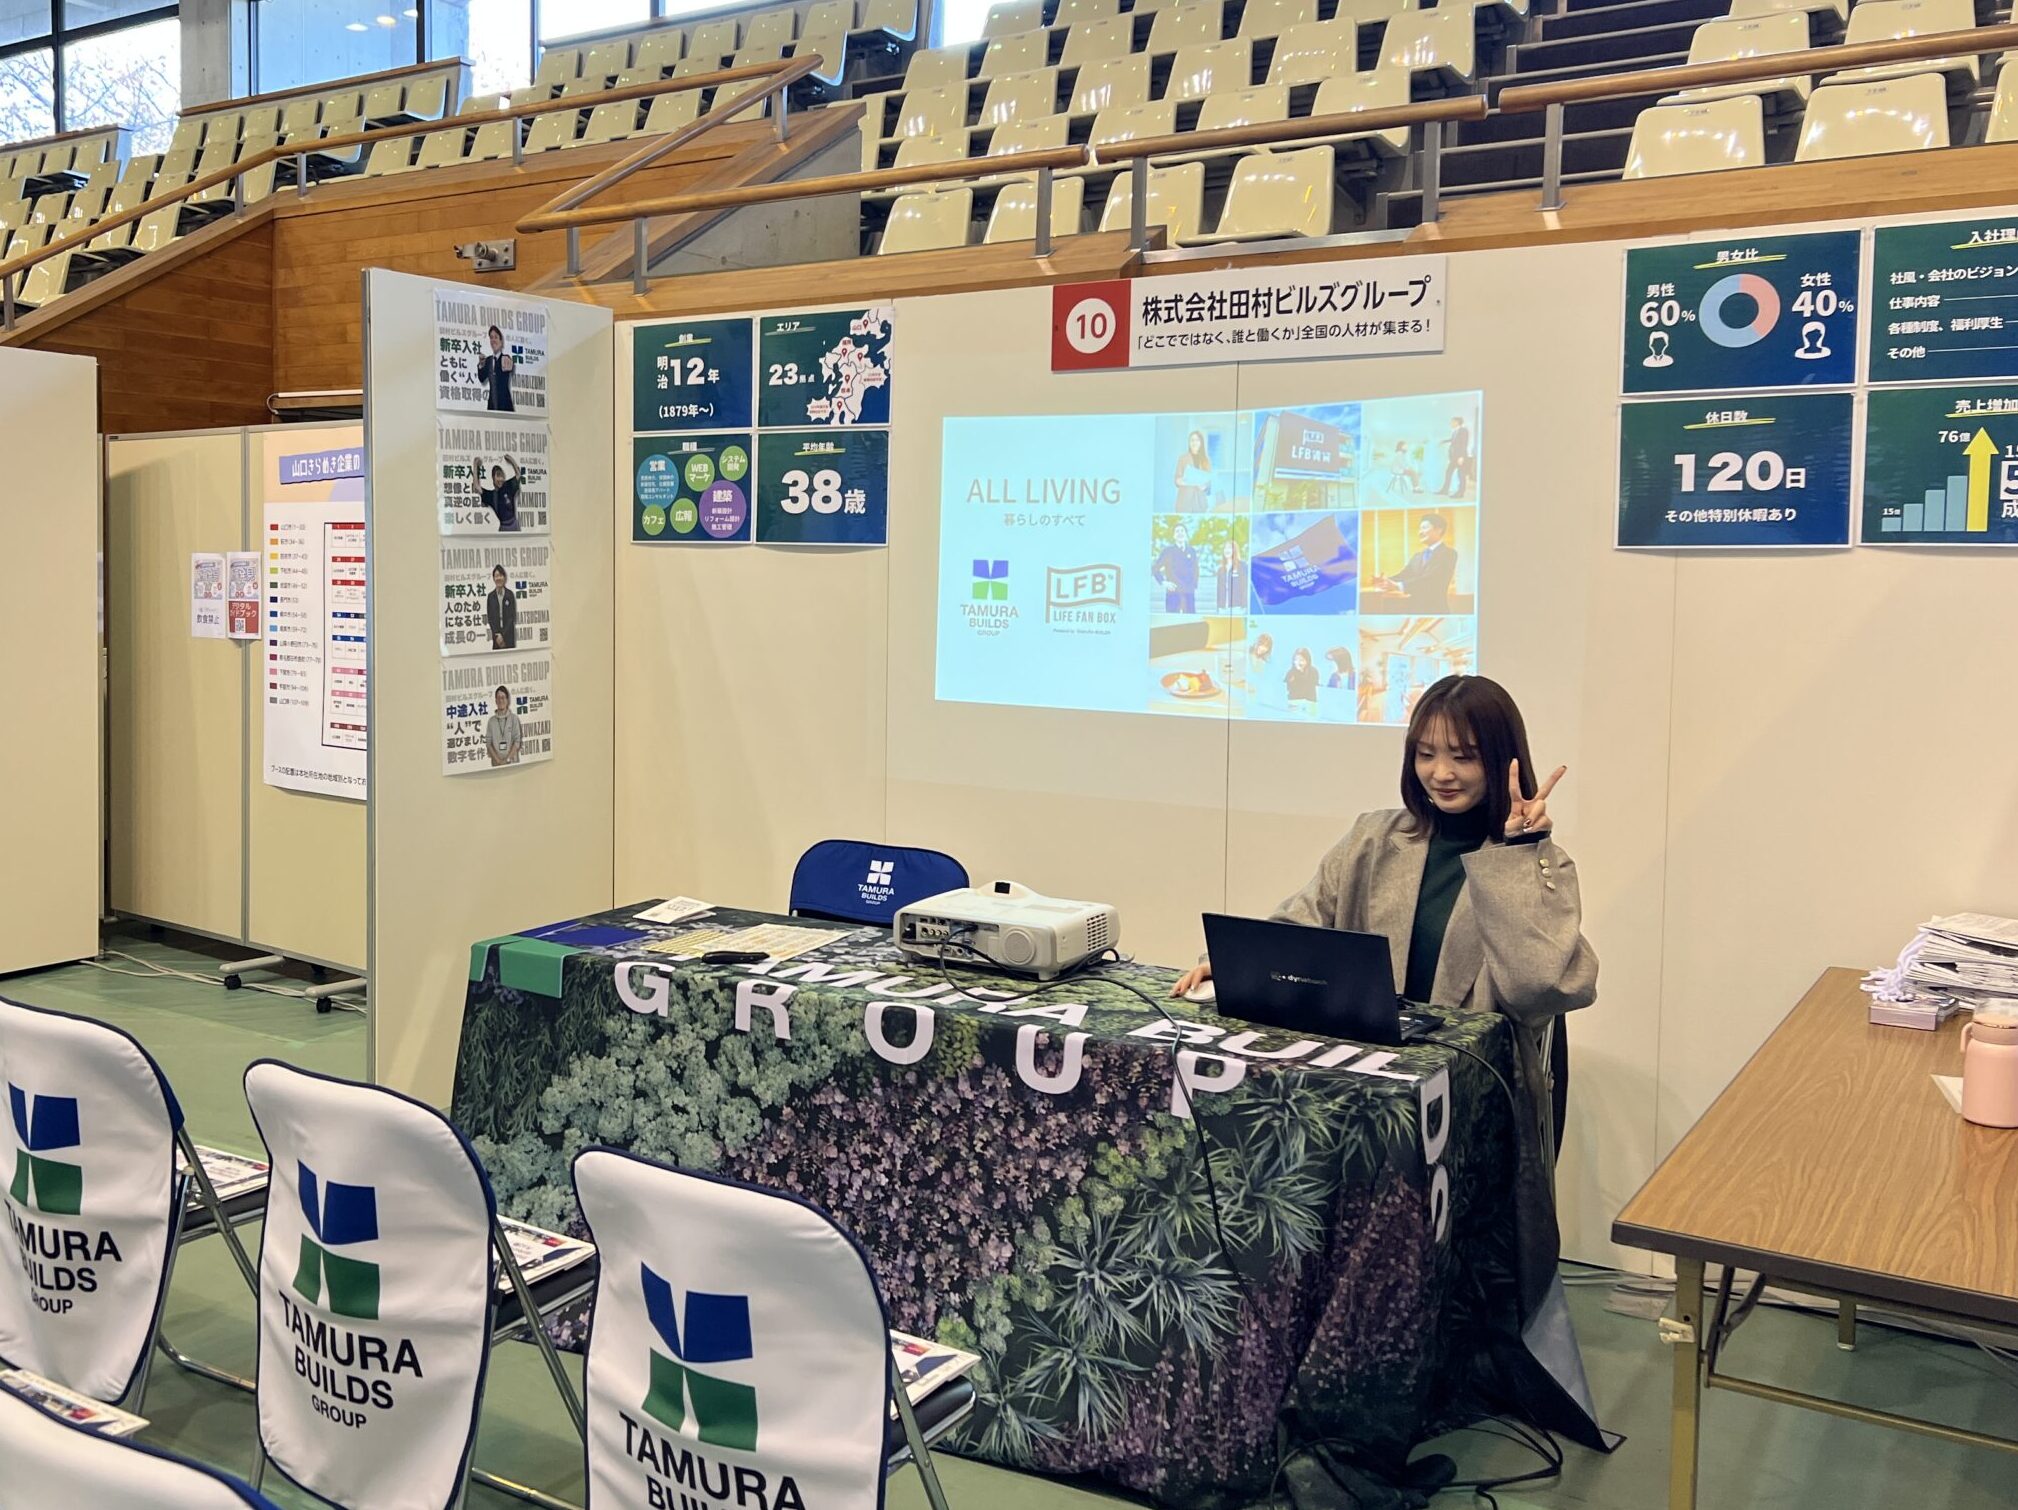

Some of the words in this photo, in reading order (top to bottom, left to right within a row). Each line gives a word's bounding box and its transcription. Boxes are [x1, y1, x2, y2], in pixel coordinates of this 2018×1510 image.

[1969, 228, 2018, 244] 入社理
[1716, 248, 1760, 263] 男女比
[1800, 272, 1831, 287] 女性
[1646, 282, 1675, 298] 男性
[1142, 275, 1432, 326] 株式会社田村ビルズグループ
[1791, 289, 1854, 318] 40%
[1889, 295, 1940, 309] 仕事内容
[436, 300, 478, 326] TAMURA
[480, 306, 514, 330] BUILDS
[516, 310, 546, 334] GROUP
[1640, 299, 1696, 328] 60%
[777, 322, 801, 332] エリア
[1076, 312, 1107, 339] 10
[440, 338, 482, 355] 新卒入社
[1888, 346, 1926, 359] その他
[440, 356, 468, 369] ともに
[1705, 410, 1748, 424] 休日数
[439, 429, 482, 451] TAMURA
[485, 430, 517, 452] BUILDS
[520, 432, 547, 453] GROUP
[1938, 430, 1971, 443] 76億
[292, 454, 360, 477] 山口きらめき企業の
[691, 464, 709, 473] WEB
[1674, 450, 1806, 492] 120日
[690, 473, 710, 482] マーケ
[713, 490, 733, 503] 建築
[780, 469, 866, 514] 38歳
[967, 479, 1016, 503] ALL
[1027, 479, 1121, 504] LIVING
[643, 516, 665, 525] カフェ
[675, 510, 692, 521] 広報
[1004, 514, 1086, 526] 暮らしのすべて
[1665, 508, 1797, 523] その他特別休暇あり
[441, 549, 482, 569] TAMURA
[520, 547, 549, 567] GROUP
[445, 584, 487, 598] 新卒入社
[231, 602, 251, 610] デジタル
[445, 601, 481, 614] 人のため
[960, 604, 1019, 618] TAMURA
[969, 618, 1009, 629] BUILDS
[1054, 611, 1073, 622] LIFE
[1076, 611, 1094, 623] FAN
[1097, 612, 1116, 624] BOX
[443, 667, 483, 691] TAMURA
[486, 664, 518, 686] BUILDS
[521, 661, 550, 682] GROUP
[446, 702, 488, 719] 中途入社
[858, 884, 895, 895] TAMURA
[861, 893, 888, 901] BUILDS
[614, 962, 1247, 1119] GROUP
[279, 1288, 423, 1378] TAMURA
[295, 1349, 394, 1410] BUILDS
[311, 1395, 367, 1429] GROUP
[619, 1411, 806, 1510] TAMURA
